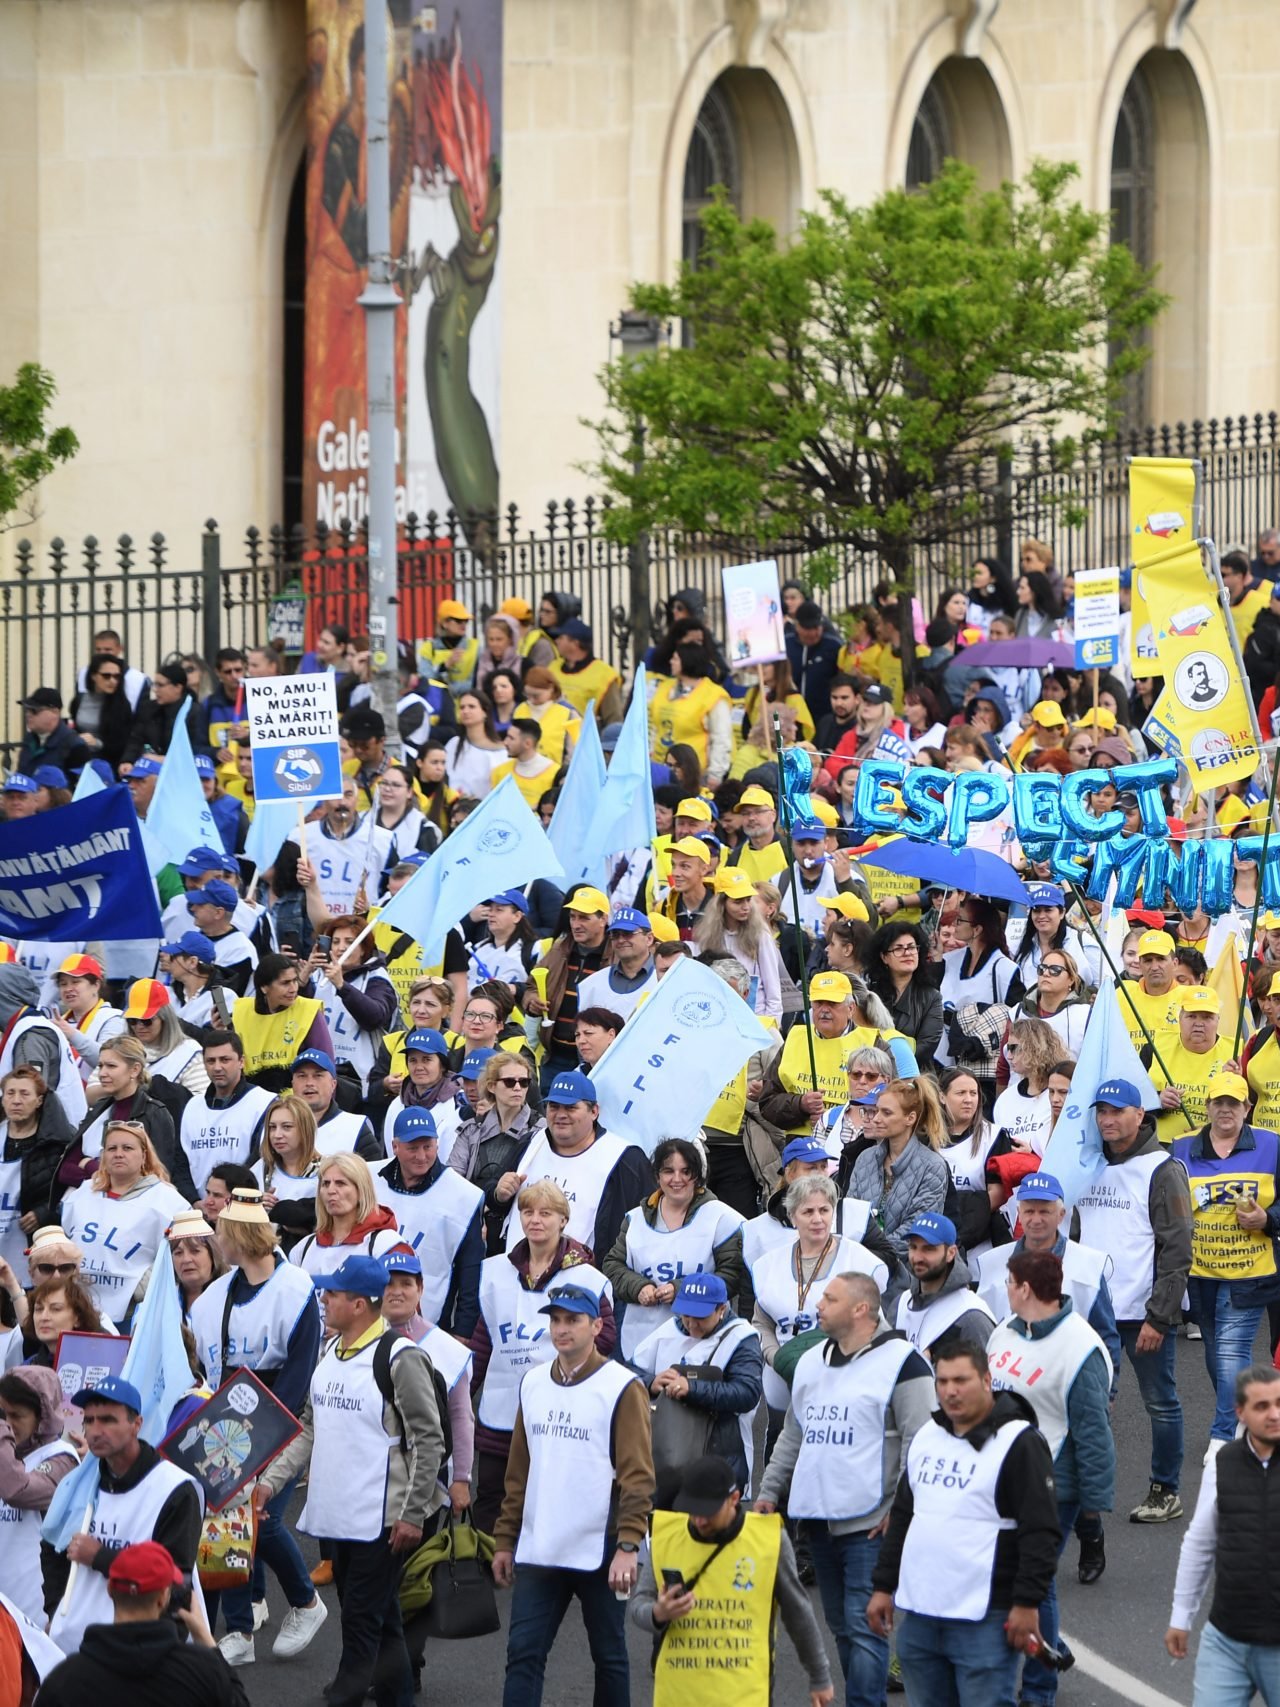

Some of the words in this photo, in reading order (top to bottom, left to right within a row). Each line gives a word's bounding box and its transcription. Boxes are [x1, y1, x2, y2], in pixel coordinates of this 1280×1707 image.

[252, 687, 276, 697] NO,
[283, 683, 327, 694] AMU-I
[268, 698, 317, 709] MUSAI
[254, 711, 273, 725] SĂ
[279, 709, 333, 725] MĂRIȚI
[257, 725, 332, 740] SALARUL!
[1204, 729, 1249, 752] CNSLR
[287, 749, 306, 759] SIP
[195, 755, 210, 768] SLI
[288, 783, 312, 793] Sibiu
[780, 747, 1178, 850] RESPECT
[1008, 1122, 1044, 1136] RANCEA
[1194, 1220, 1245, 1231] Sindicat
[385, 1256, 406, 1267] FSLI
[1195, 1257, 1254, 1271] București
[685, 1284, 707, 1295] FSLI
[326, 1383, 345, 1394] SIPA
[327, 1396, 362, 1411] VITEAZUL
[920, 1456, 976, 1475] FSLI
[917, 1471, 971, 1489] ILFOV
[693, 1599, 745, 1612] DERAȚIA
[669, 1637, 687, 1650] DIN
